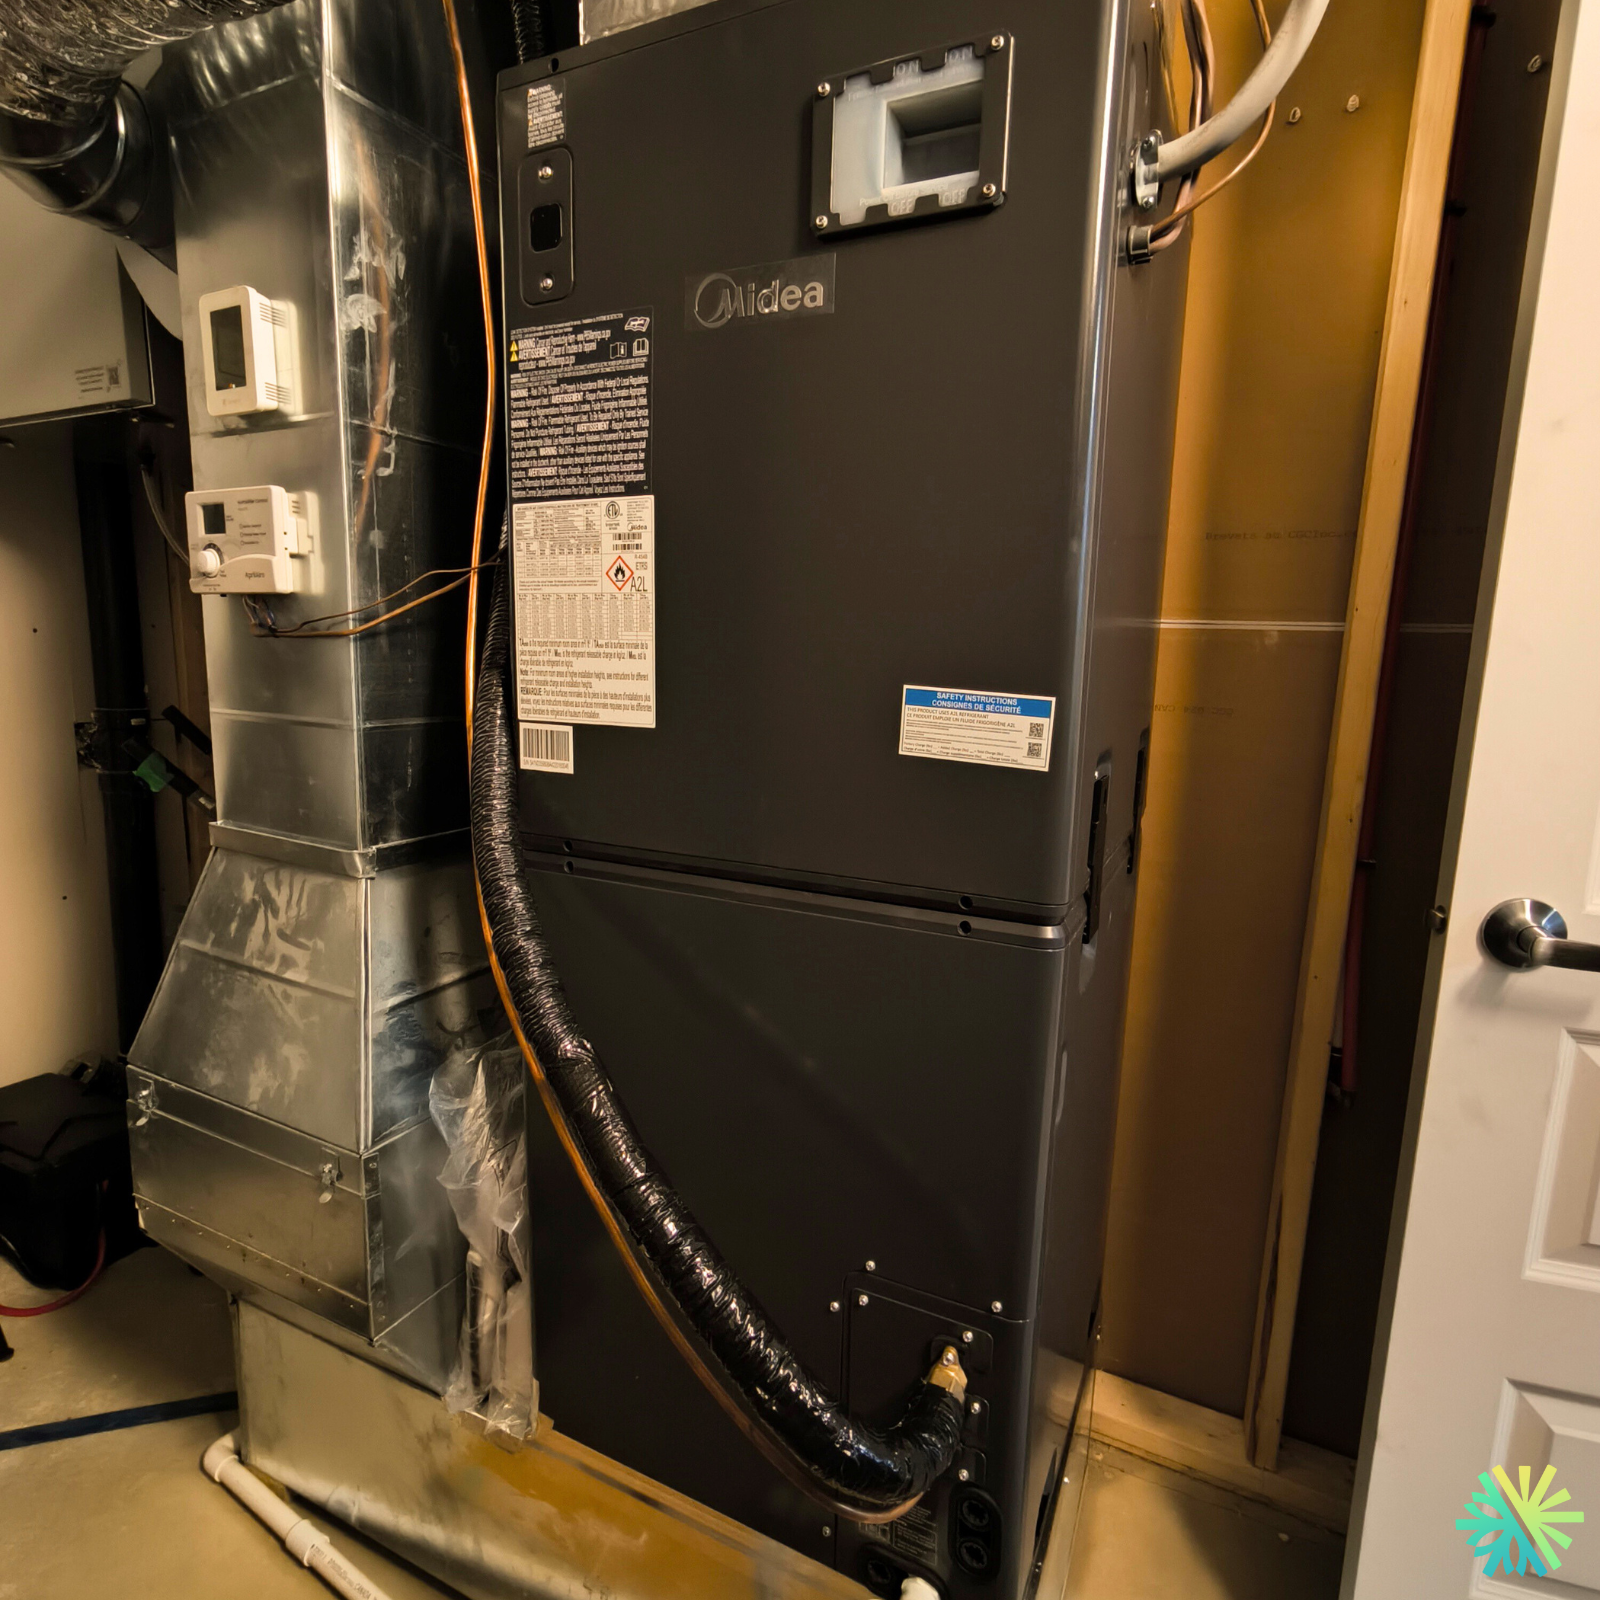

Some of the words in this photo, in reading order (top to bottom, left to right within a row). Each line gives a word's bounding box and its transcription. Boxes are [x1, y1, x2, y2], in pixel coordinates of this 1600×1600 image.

[694, 272, 824, 329] Midea
[627, 522, 648, 532] Midea
[630, 576, 648, 592] A2L
[936, 692, 964, 701] SAFETY
[965, 694, 1018, 706] INSTRUCTIONS
[932, 700, 972, 710] CONSIGNES
[985, 703, 1022, 714] SÉCURITÉ
